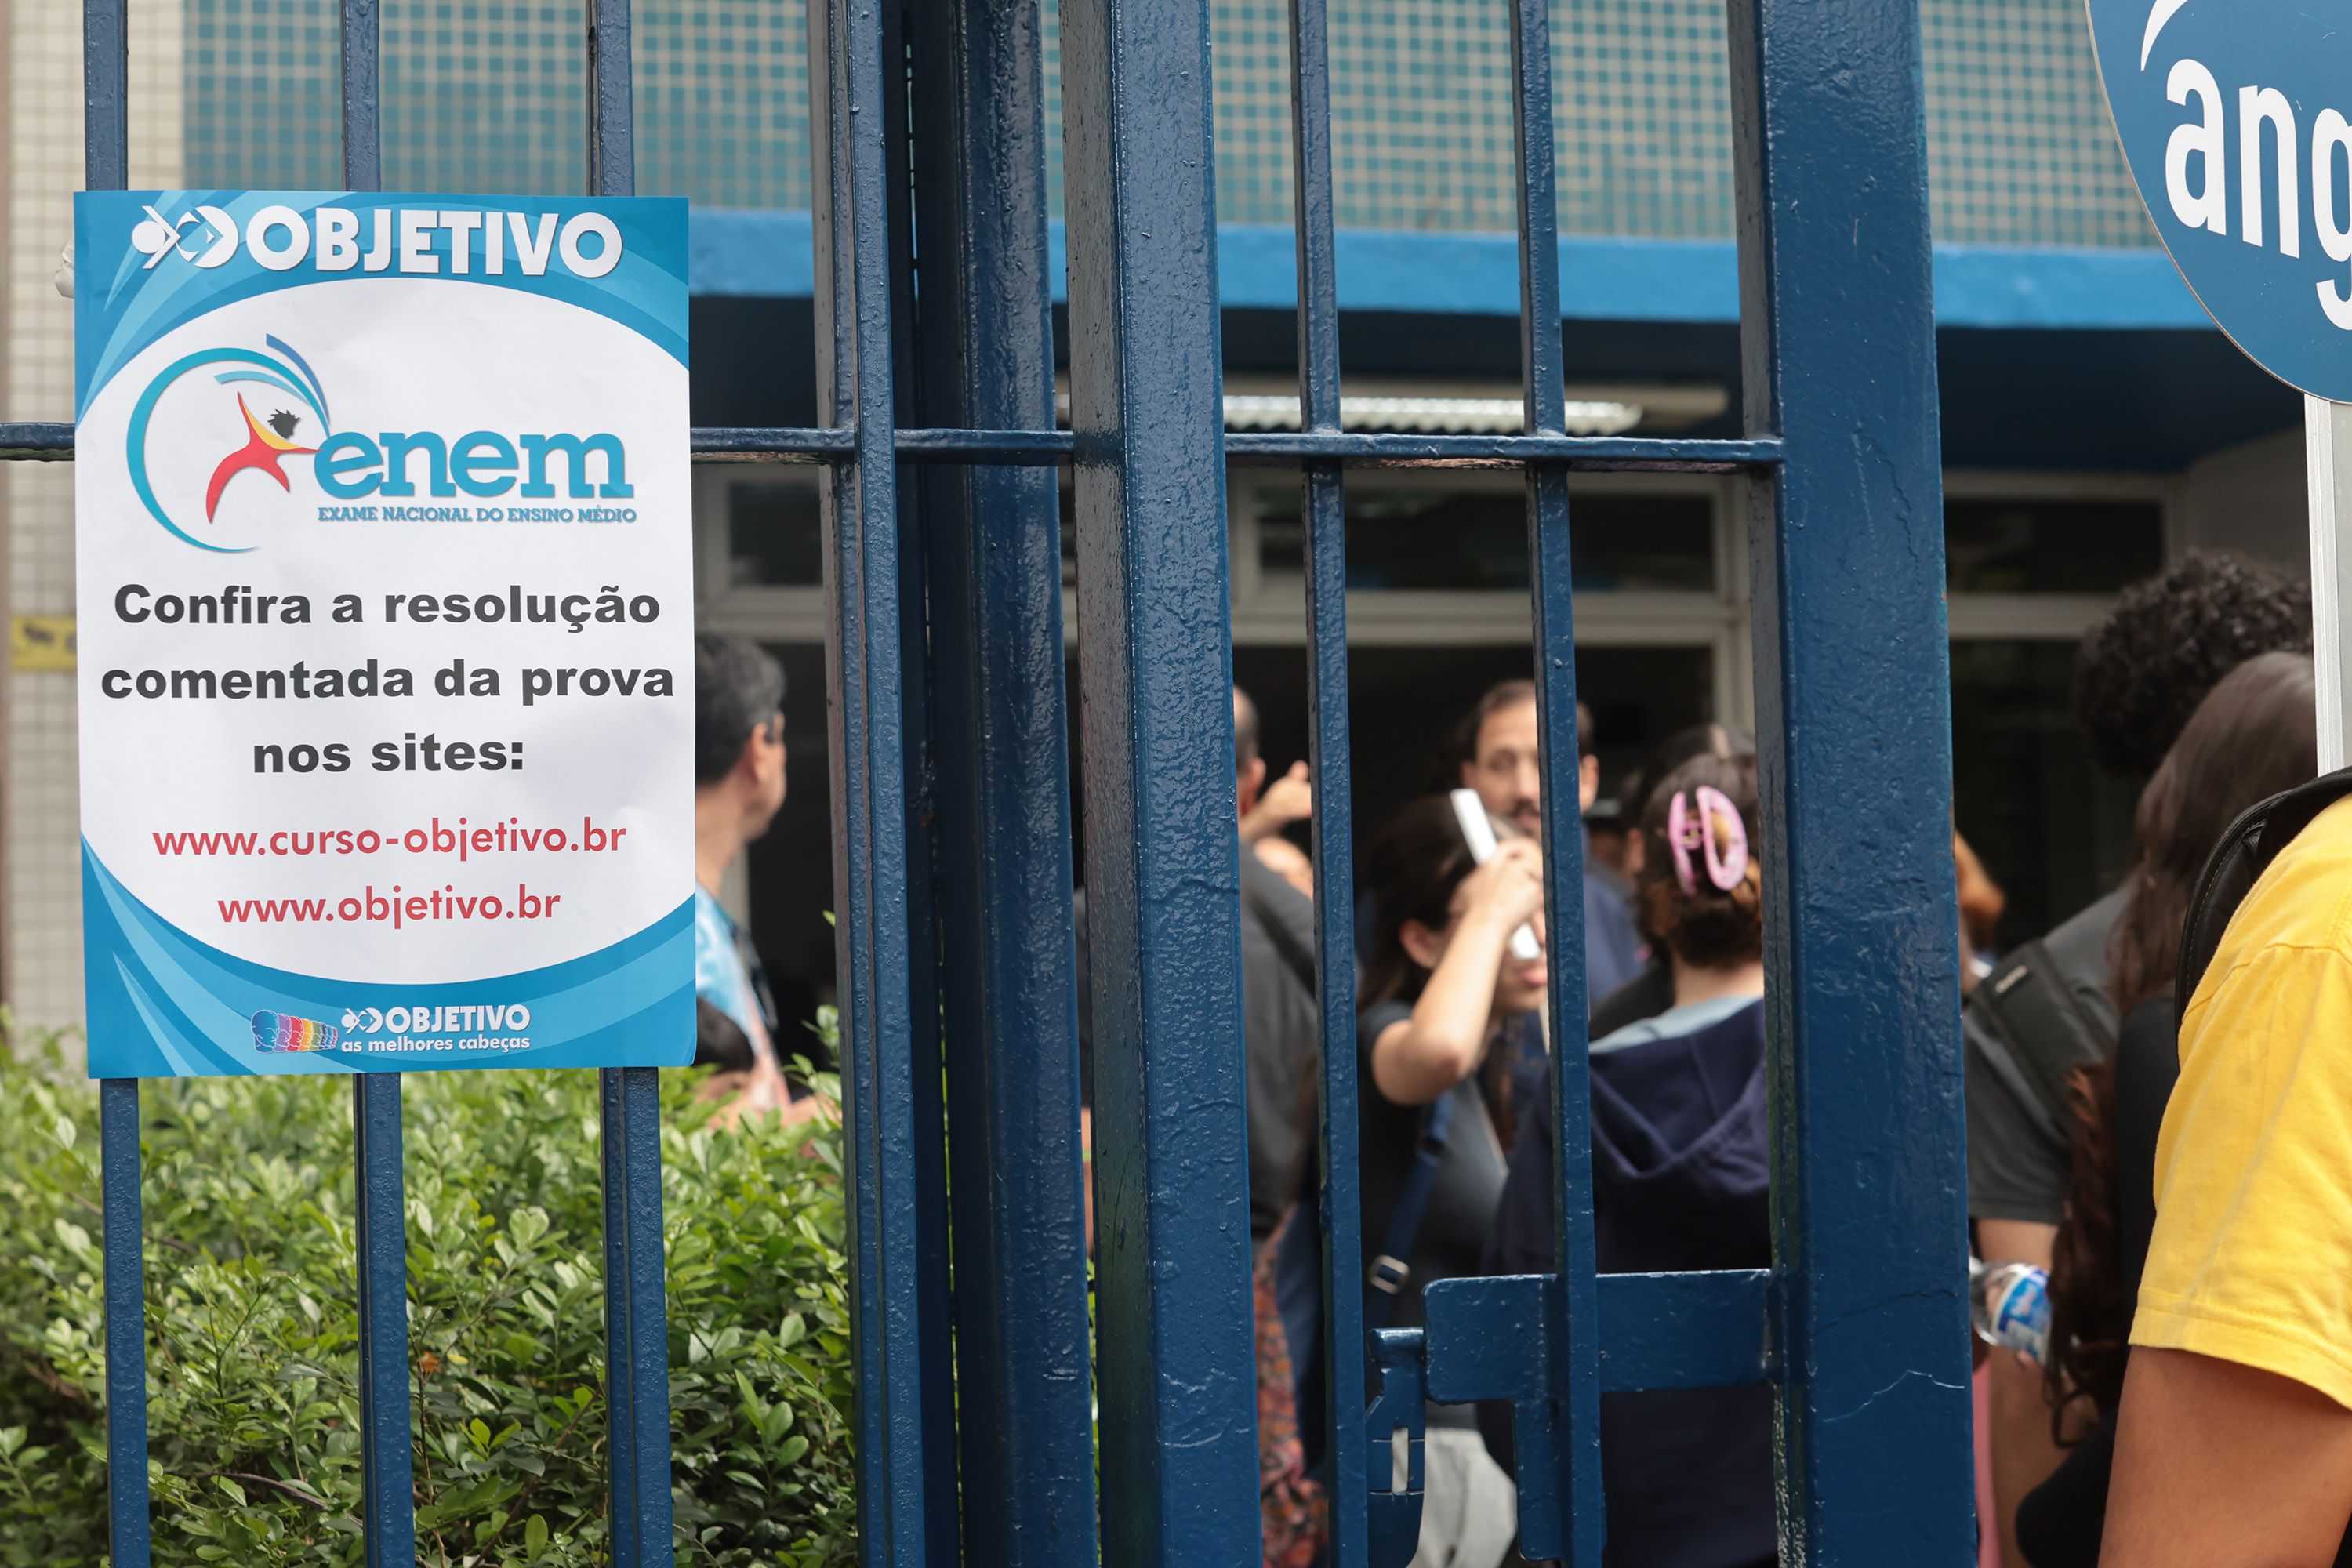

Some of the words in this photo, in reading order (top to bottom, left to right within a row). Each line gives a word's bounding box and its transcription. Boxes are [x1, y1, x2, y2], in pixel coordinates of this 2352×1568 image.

[246, 205, 622, 278] OBJETIVO
[313, 430, 634, 499] enem
[318, 506, 378, 522] EXAME
[383, 506, 472, 523] NACIONAL
[477, 508, 503, 523] DO
[508, 508, 574, 524] ENSINO
[578, 504, 637, 524] MÉDIO
[114, 584, 311, 625] Confira
[332, 594, 363, 624] a
[384, 586, 660, 633] resolução
[101, 659, 413, 699] comentada
[434, 659, 500, 697] da
[522, 666, 674, 706] prova
[253, 743, 351, 774] nos
[370, 732, 524, 771] sites:
[153, 817, 627, 862] www.curso-objetivo.br
[217, 884, 561, 929] www.objetivo.br
[385, 1004, 530, 1033] OBJETIVO
[341, 1041, 362, 1052] as
[368, 1036, 453, 1052] melhores
[459, 1035, 530, 1053] cabeças
